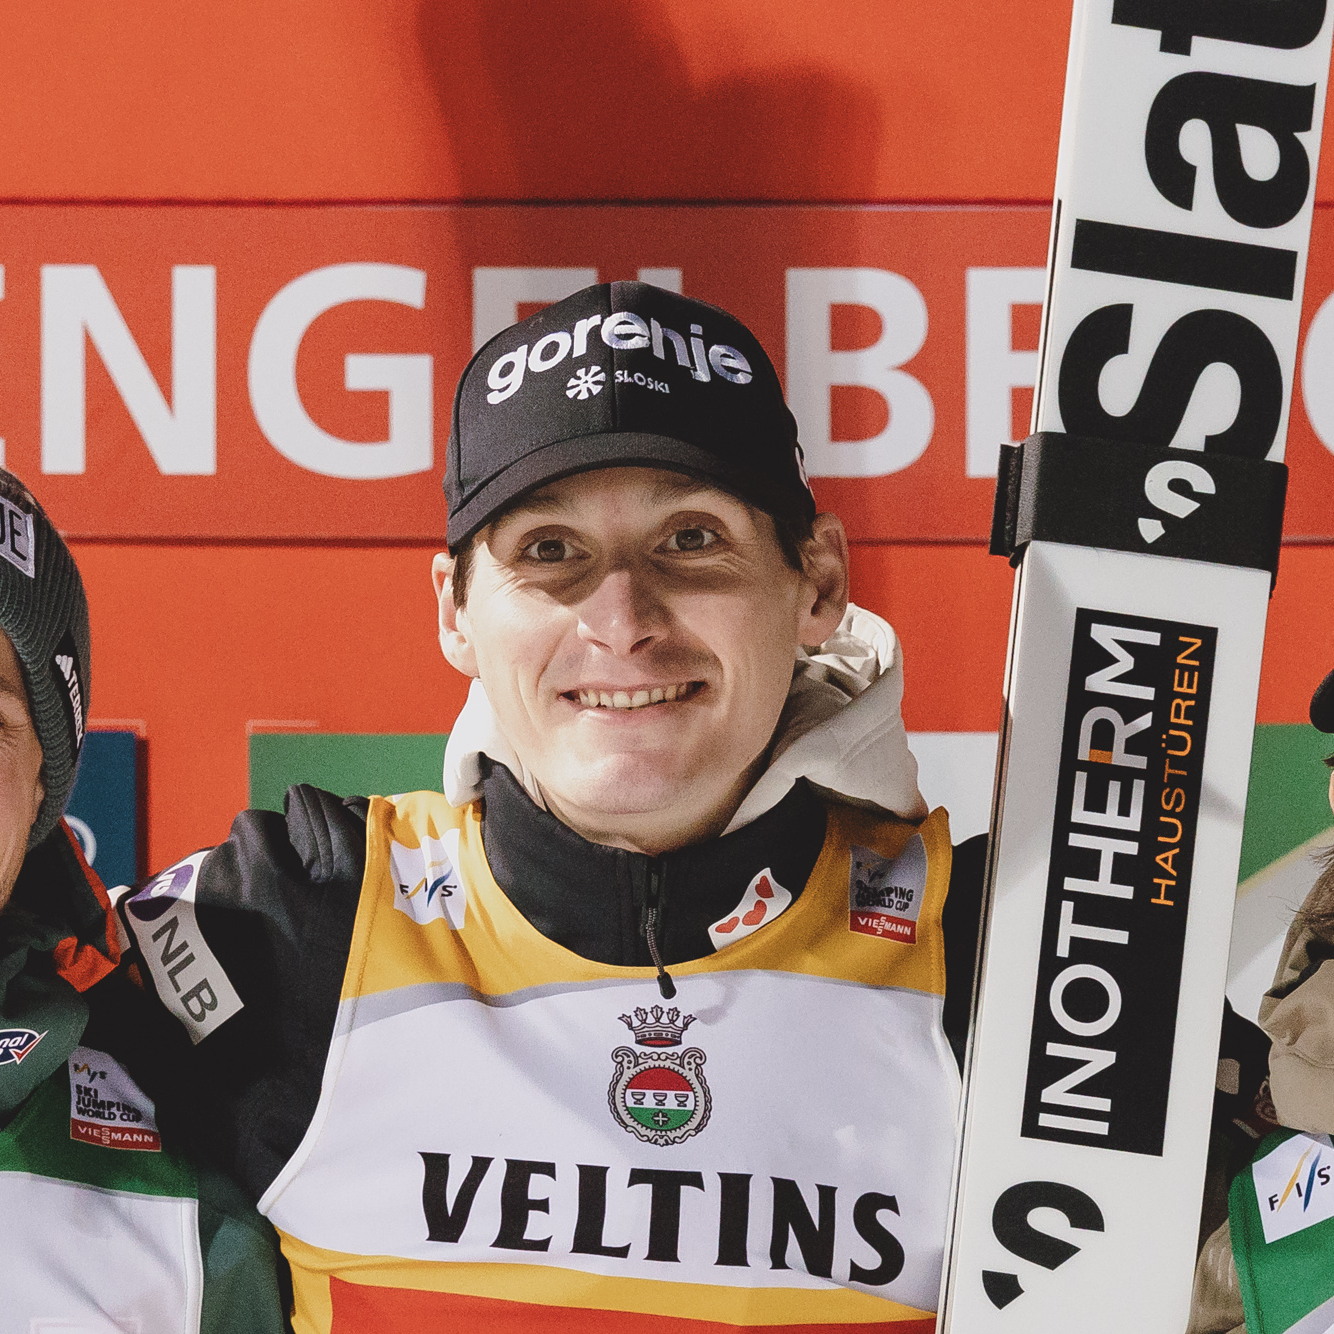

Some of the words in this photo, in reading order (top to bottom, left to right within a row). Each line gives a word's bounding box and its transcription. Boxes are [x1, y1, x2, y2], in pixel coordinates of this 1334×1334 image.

[487, 311, 753, 404] gorenje
[1150, 635, 1203, 907] HAUSTÜREN
[399, 877, 458, 898] FIS
[1038, 619, 1162, 1136] INOTHERM
[857, 916, 912, 936] VIESSMANN
[151, 915, 218, 1023] NLB
[75, 1083, 99, 1098] SKI
[76, 1105, 117, 1121] WORLD
[120, 1111, 143, 1123] CUP
[76, 1125, 154, 1145] VIESSMANN
[1268, 1162, 1333, 1212] FIS
[417, 1151, 907, 1287] VELTINS
